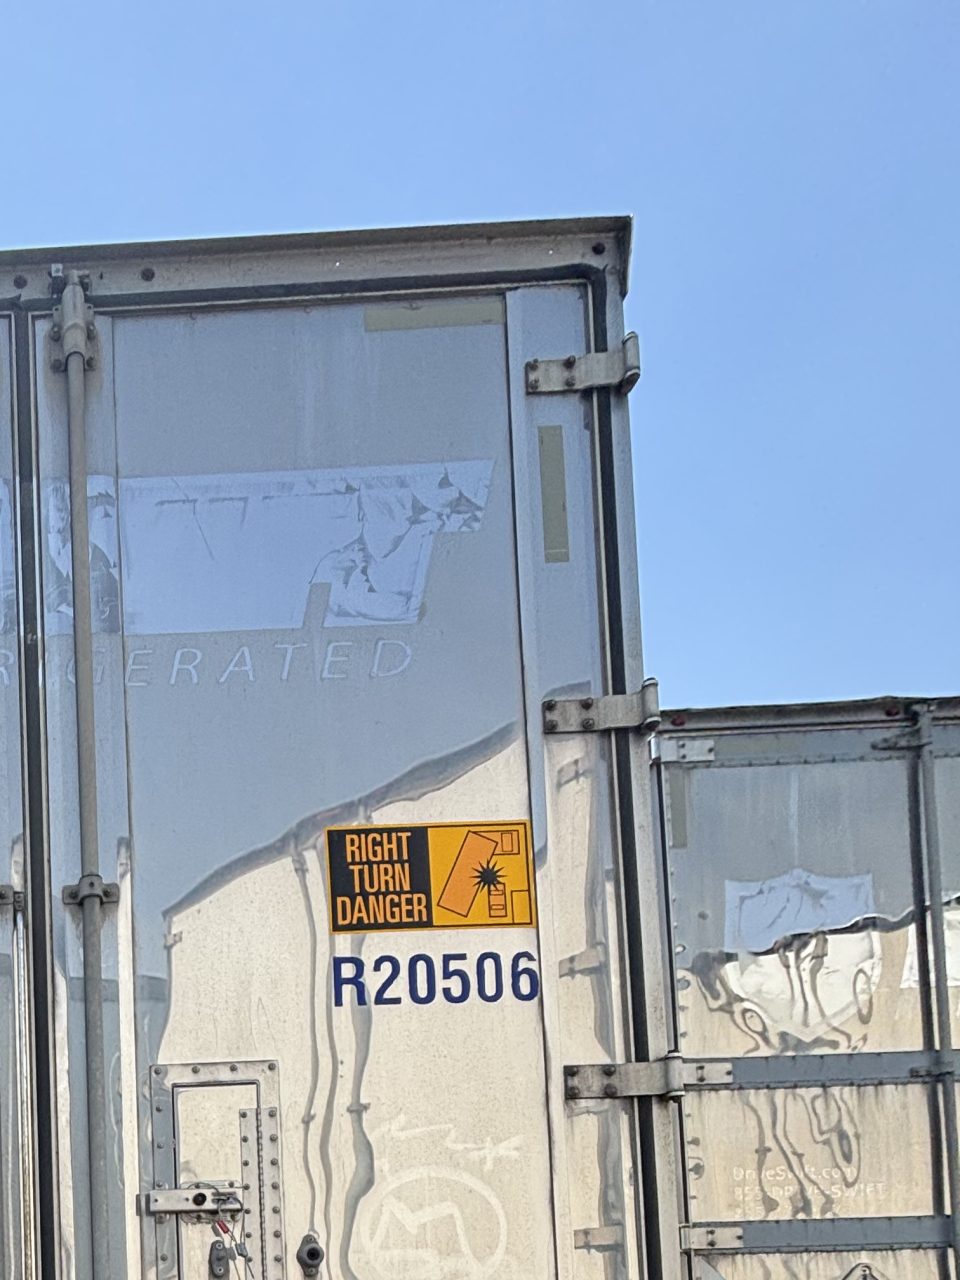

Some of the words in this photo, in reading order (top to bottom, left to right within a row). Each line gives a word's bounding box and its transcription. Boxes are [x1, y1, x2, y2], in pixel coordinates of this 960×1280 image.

[345, 831, 411, 862] RIGHT
[349, 863, 410, 893] TURN
[336, 893, 428, 925] DANGER
[332, 951, 539, 1007] R20506
